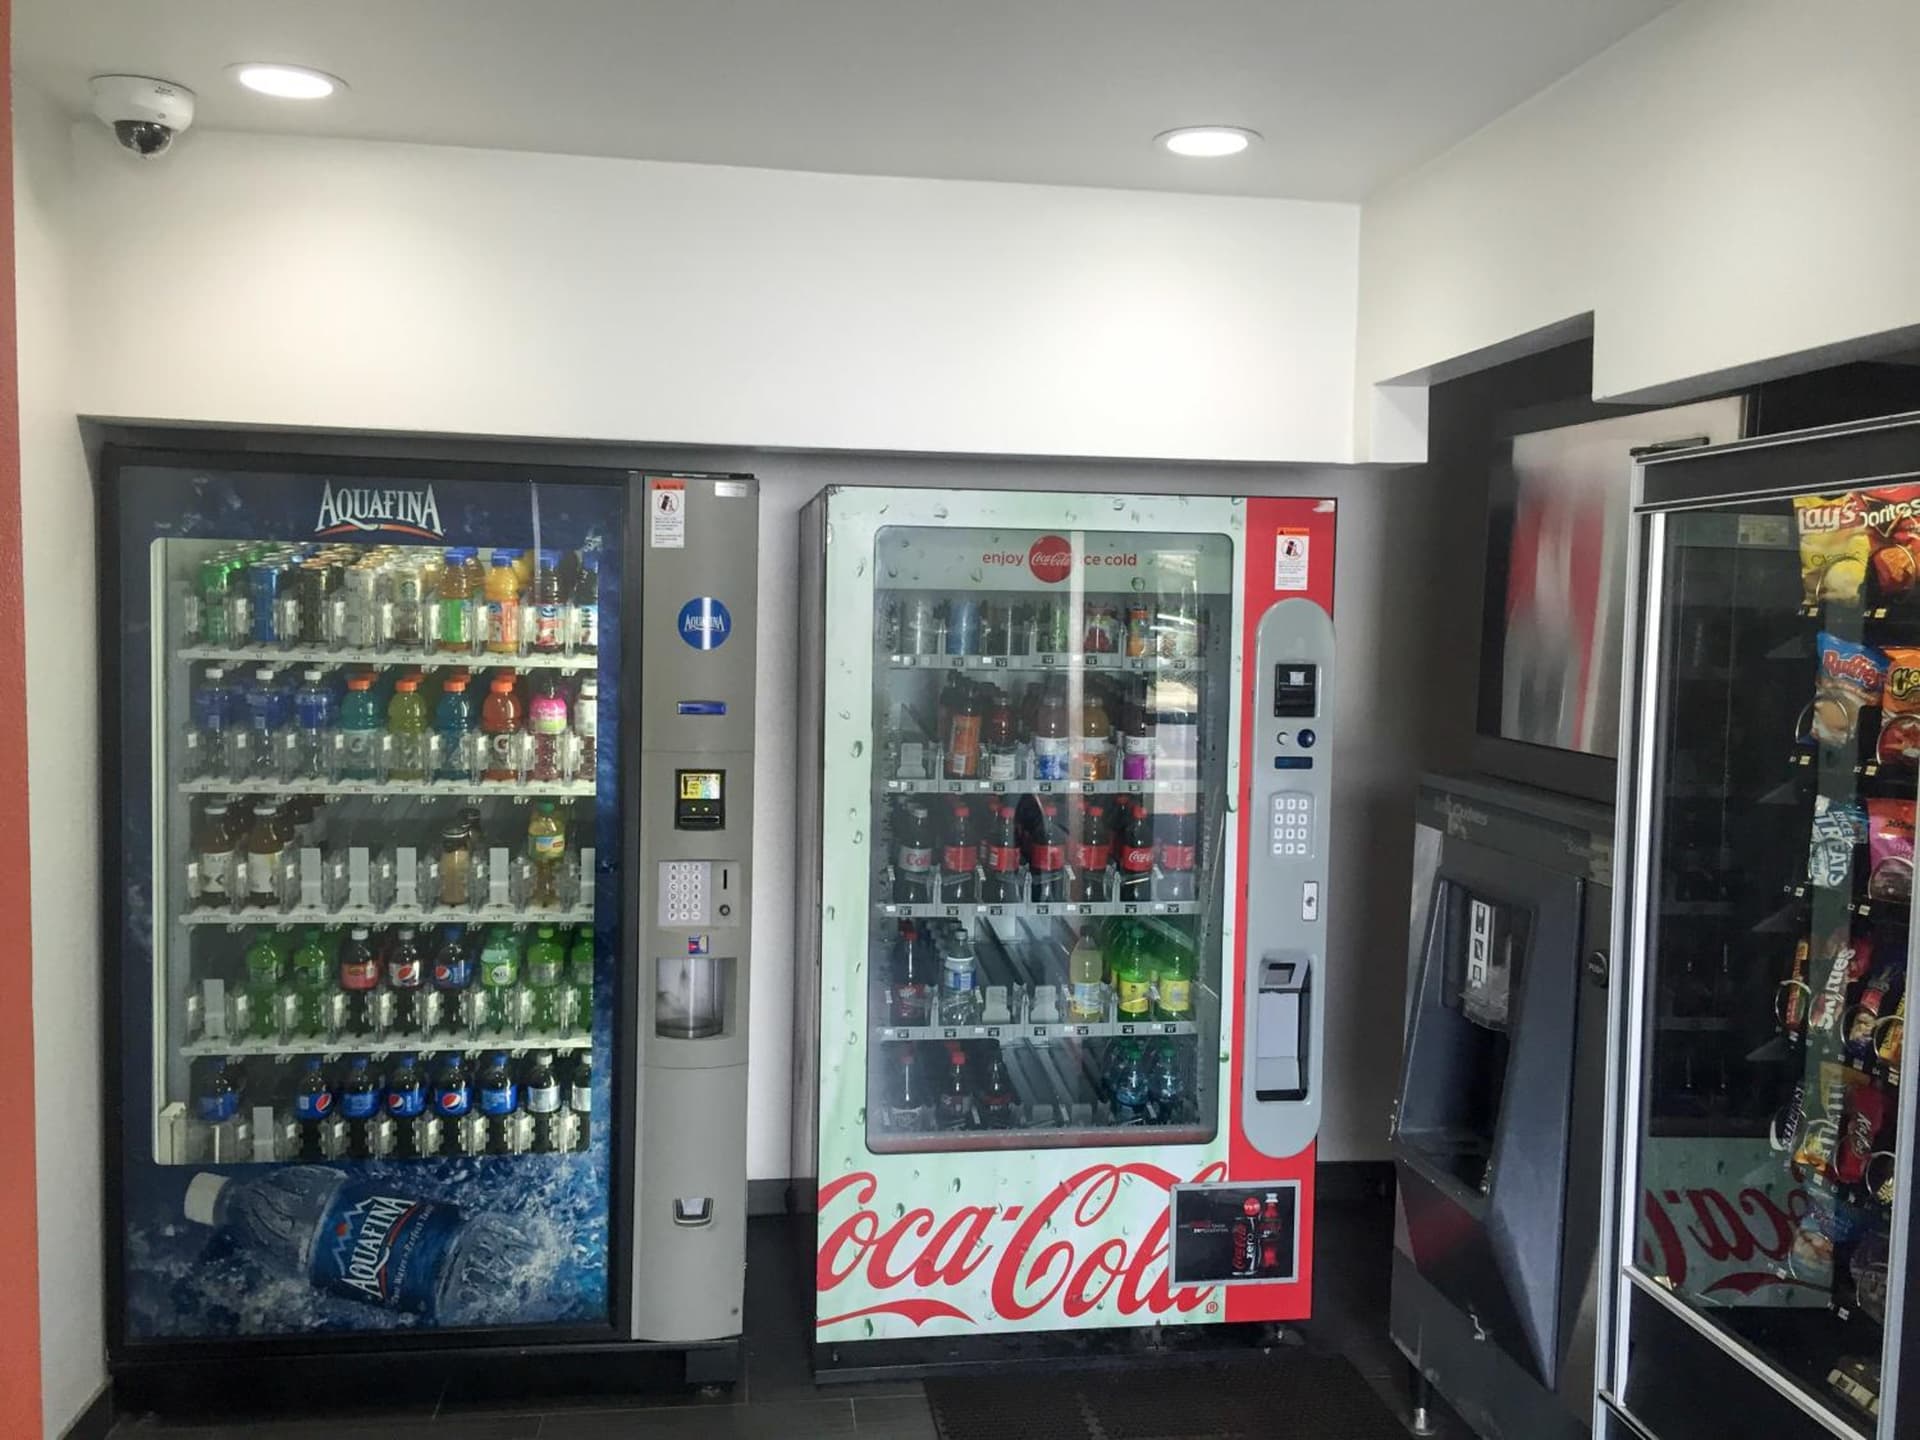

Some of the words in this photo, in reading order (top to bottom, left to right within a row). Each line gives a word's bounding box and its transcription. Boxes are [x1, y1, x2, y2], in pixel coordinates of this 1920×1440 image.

[314, 479, 444, 536] AQUAFINA
[1798, 501, 1858, 535] Lay's
[982, 552, 1024, 567] enjoy
[1081, 553, 1101, 566] ce
[1104, 553, 1137, 566] cold
[684, 613, 725, 632] AQUAINA
[341, 1195, 417, 1299] AQUAFINA
[1245, 1233, 1256, 1259] zero
